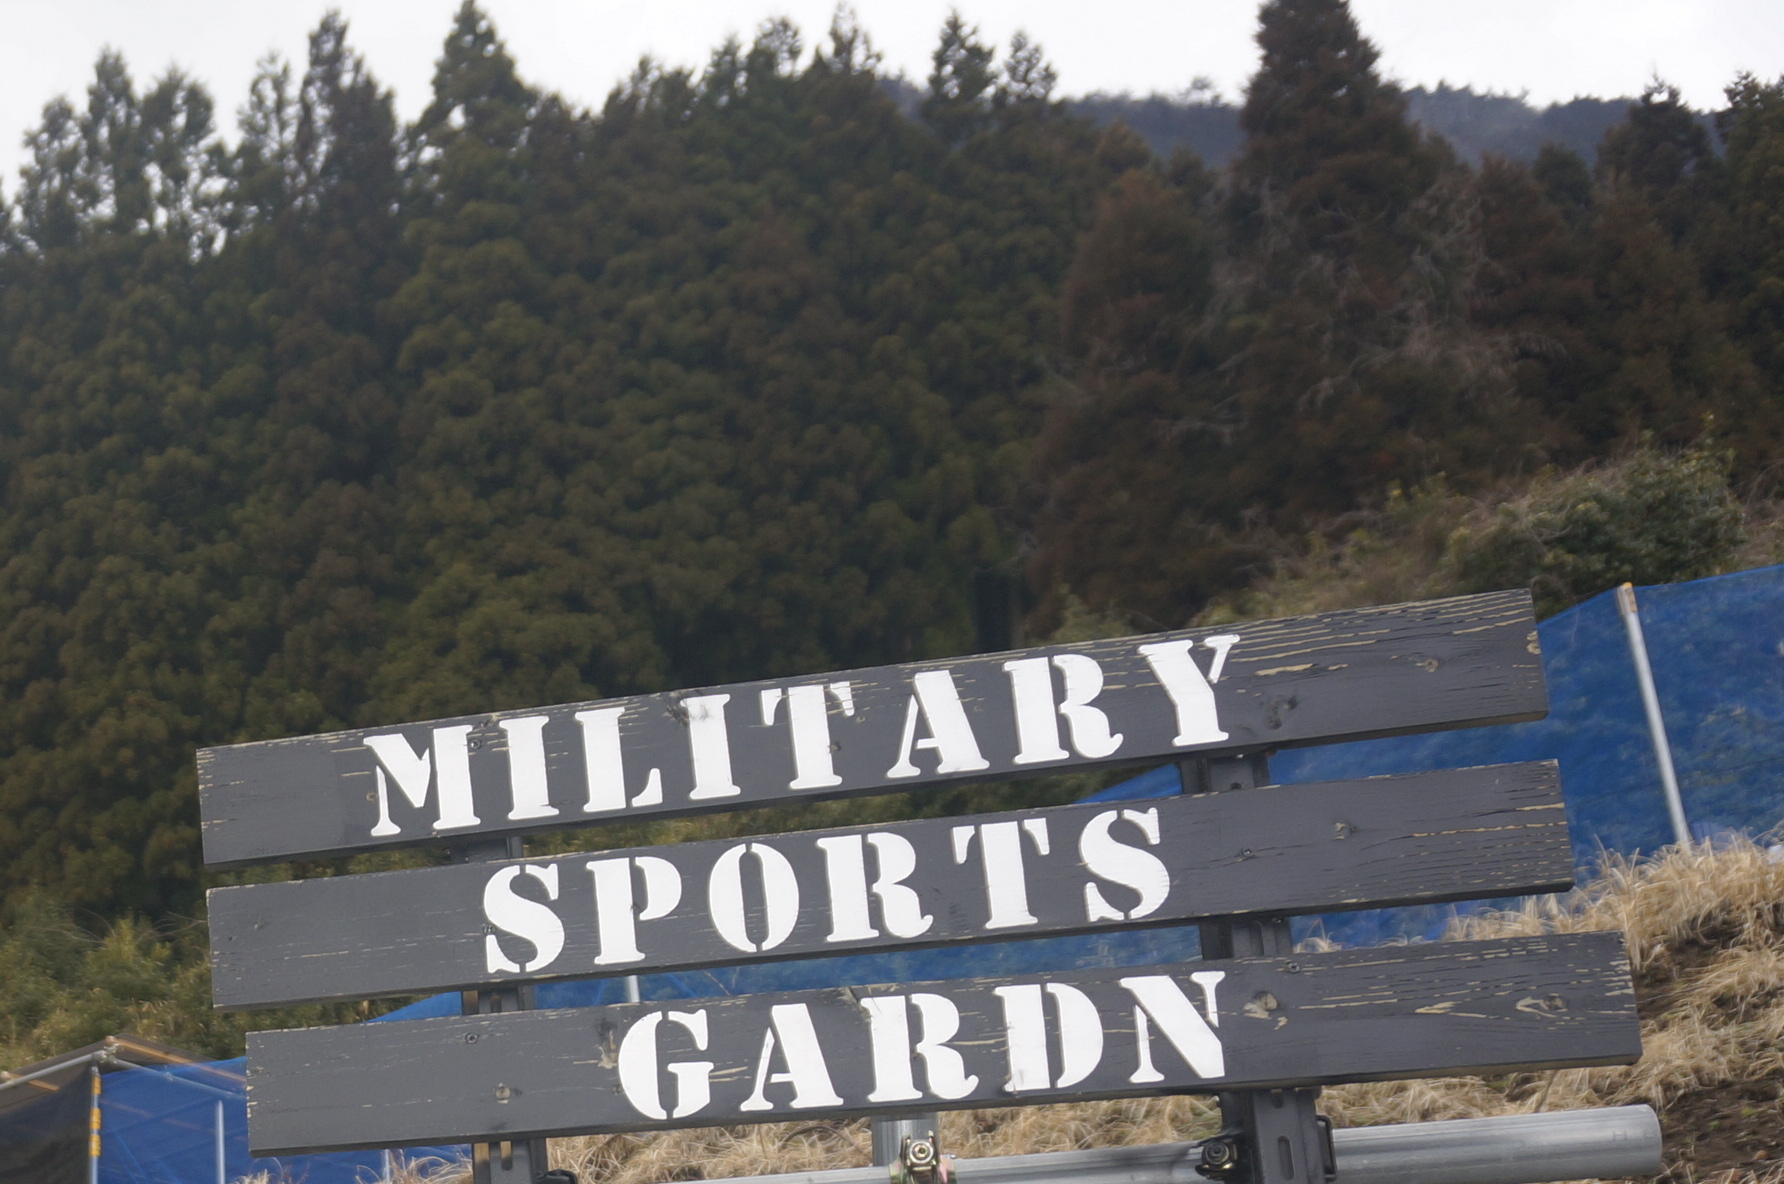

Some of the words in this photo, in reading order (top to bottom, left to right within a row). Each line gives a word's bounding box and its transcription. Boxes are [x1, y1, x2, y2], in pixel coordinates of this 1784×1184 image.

[362, 634, 1241, 838] MILITARY
[483, 807, 1172, 974] SPORTS
[617, 970, 1227, 1120] GARDN
